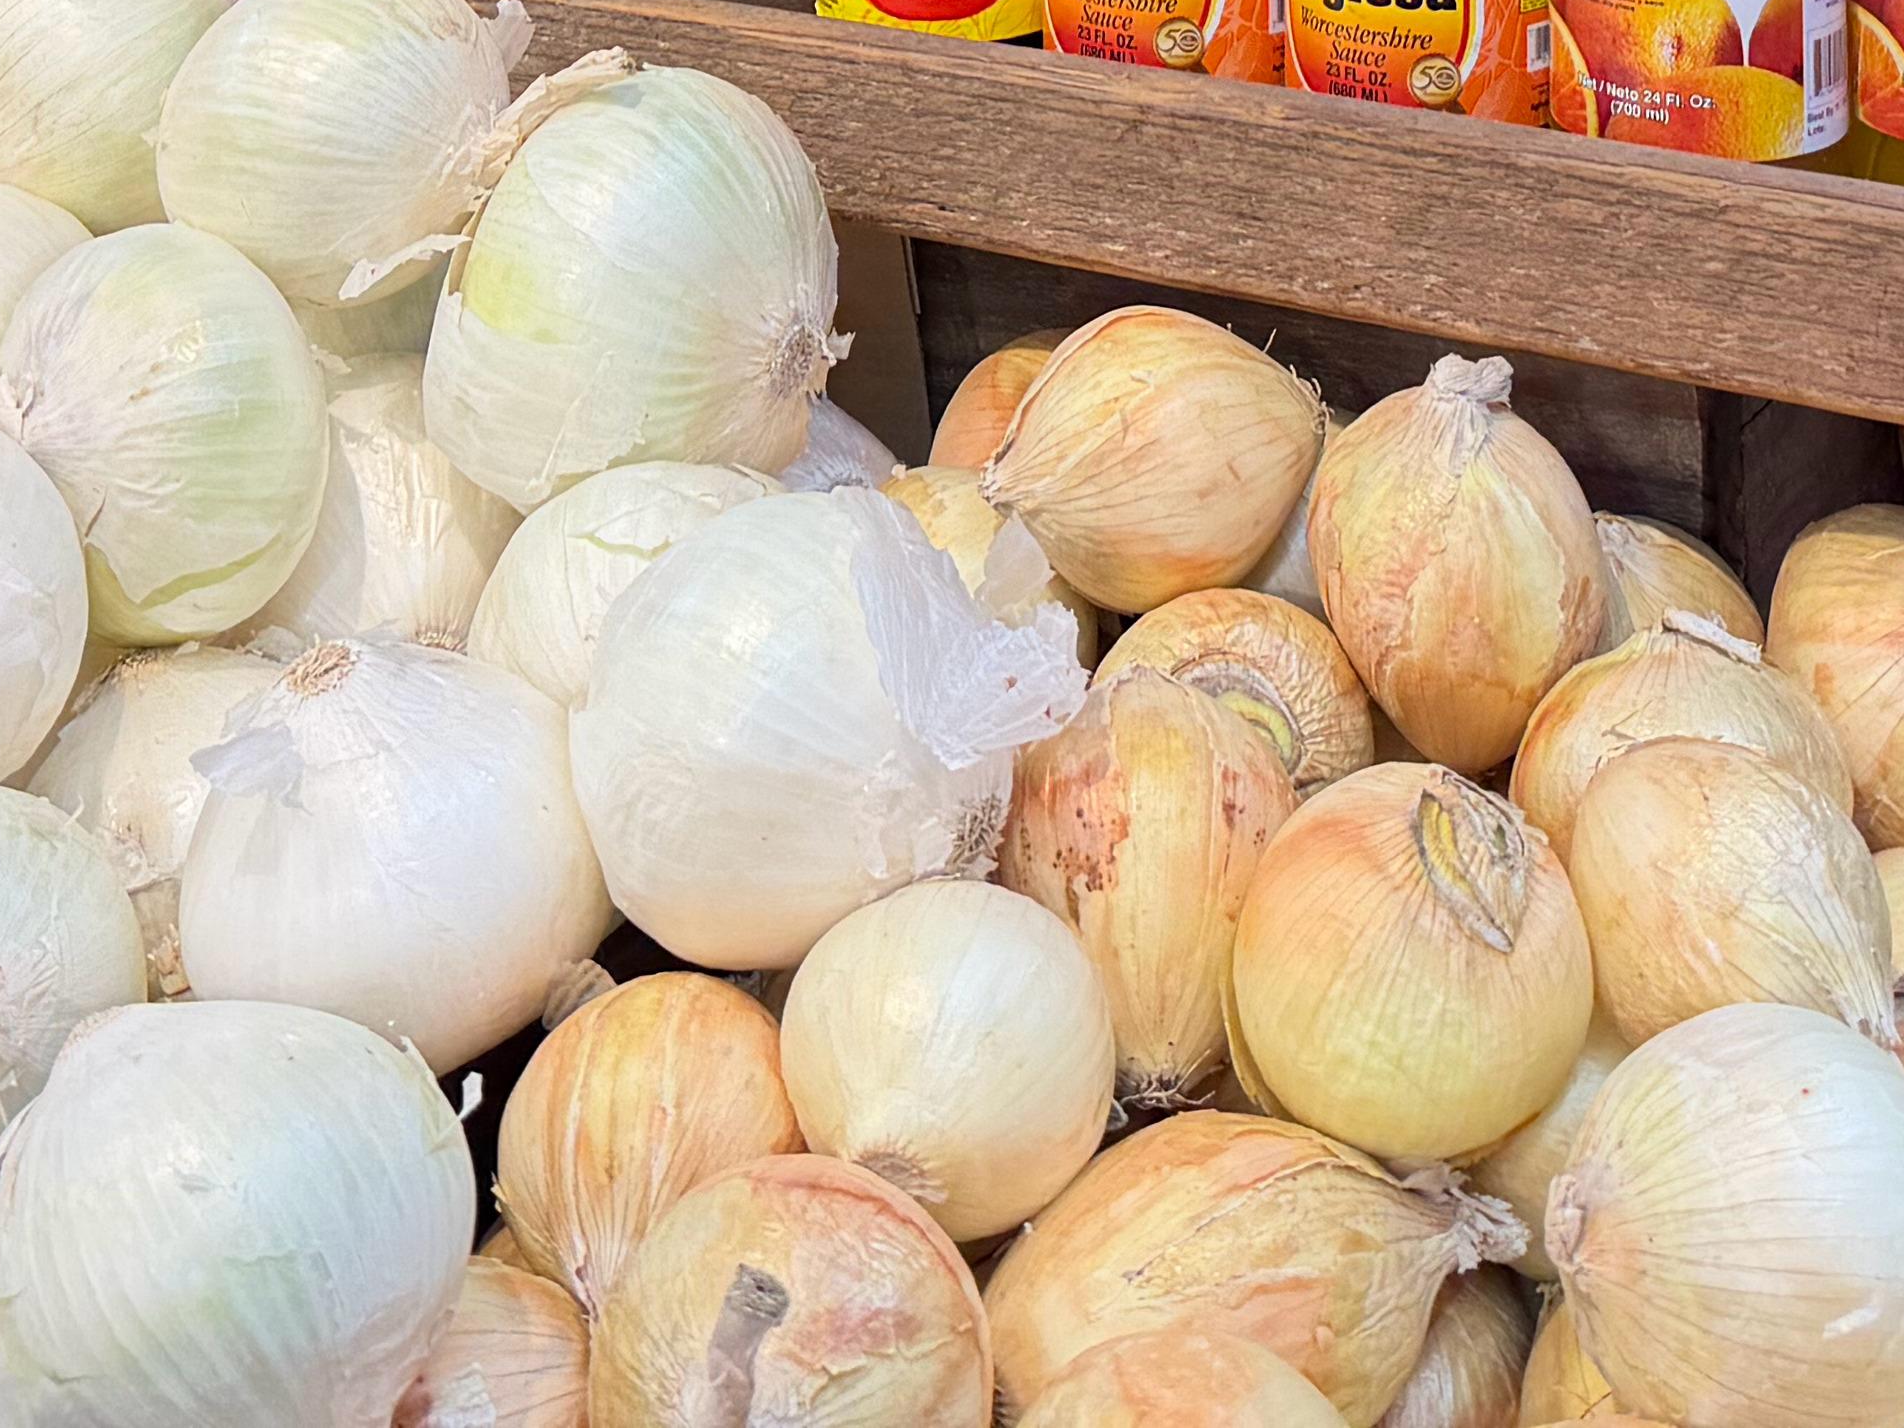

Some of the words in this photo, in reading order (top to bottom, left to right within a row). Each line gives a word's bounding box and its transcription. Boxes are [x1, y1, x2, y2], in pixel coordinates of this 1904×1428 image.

[1079, 1, 1135, 32] Sauce
[1300, 4, 1433, 50] Worcestershire
[1077, 24, 1092, 42] 23
[1329, 39, 1387, 69] Sauce
[1325, 60, 1344, 79] 23
[1345, 65, 1365, 85] FL.
[1367, 69, 1392, 88] OZ.
[1328, 79, 1358, 99] (680
[1606, 82, 1640, 103] Neto
[1642, 88, 1662, 105] 24
[1689, 93, 1718, 111] Oz.
[1610, 98, 1642, 121] (700
[1644, 103, 1671, 124] ml)
